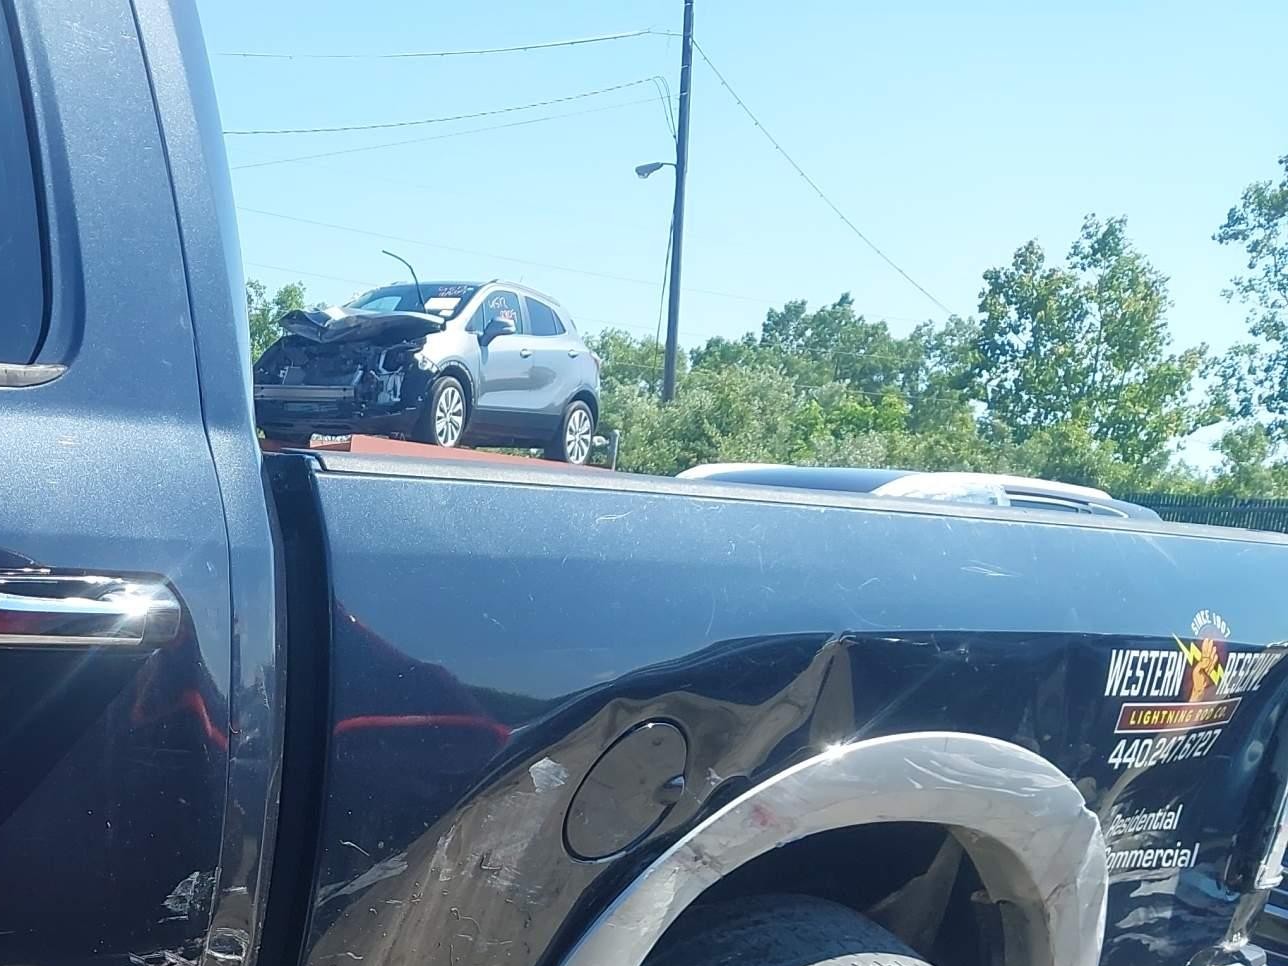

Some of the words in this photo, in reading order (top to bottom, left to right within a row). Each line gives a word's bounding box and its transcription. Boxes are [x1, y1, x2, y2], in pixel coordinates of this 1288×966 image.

[1191, 609, 1212, 636] SINCE
[1104, 649, 1187, 696] WESTERN
[1215, 652, 1281, 695] RESERVE
[1129, 709, 1193, 725] LIGHTNING
[1194, 708, 1214, 721] ROD
[1107, 729, 1222, 769] 440.247.6727
[1106, 803, 1183, 838] Residential
